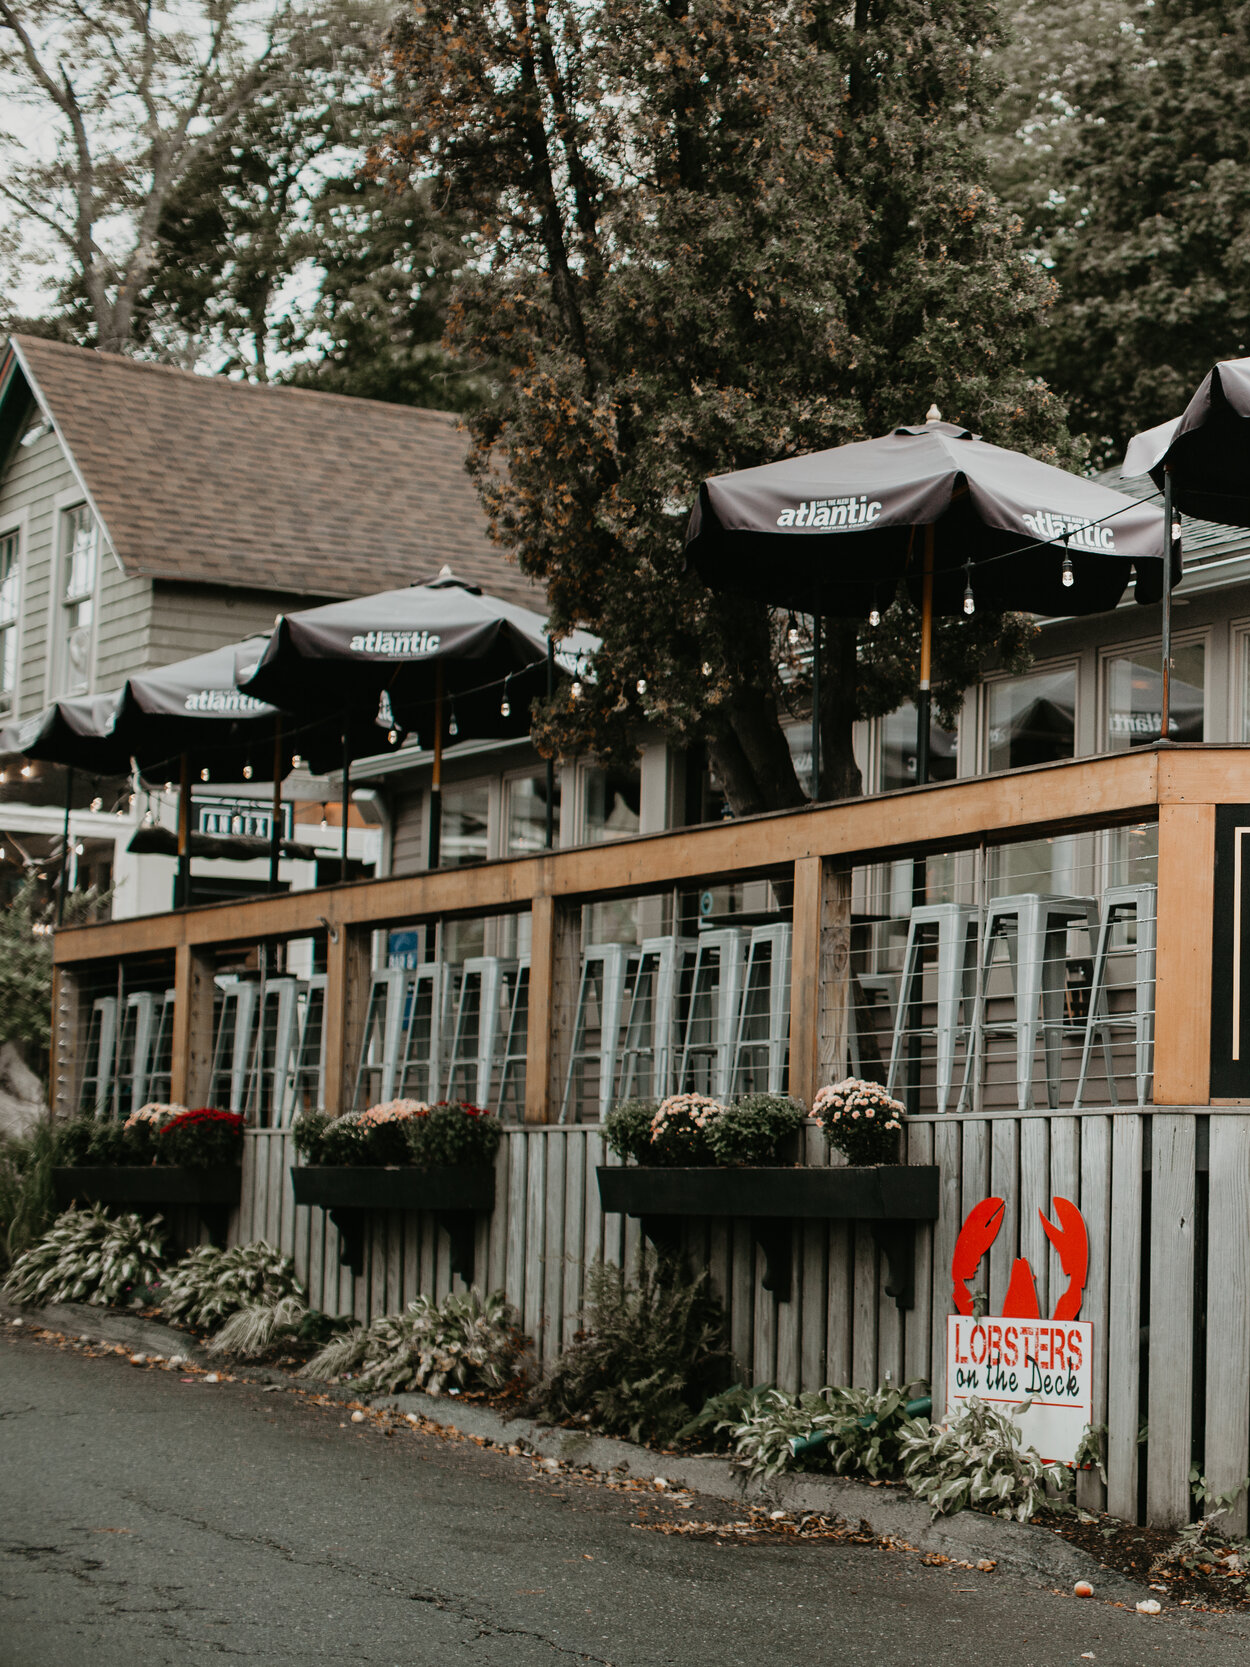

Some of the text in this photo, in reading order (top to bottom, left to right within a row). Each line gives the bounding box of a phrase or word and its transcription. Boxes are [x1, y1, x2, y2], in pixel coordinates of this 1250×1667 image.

[776, 495, 882, 527] atlantic
[1022, 510, 1115, 549] atlantic
[349, 631, 441, 653] atlantic
[955, 1323, 1083, 1372] LOBSTERS
[956, 1351, 1080, 1397] on the Deck
